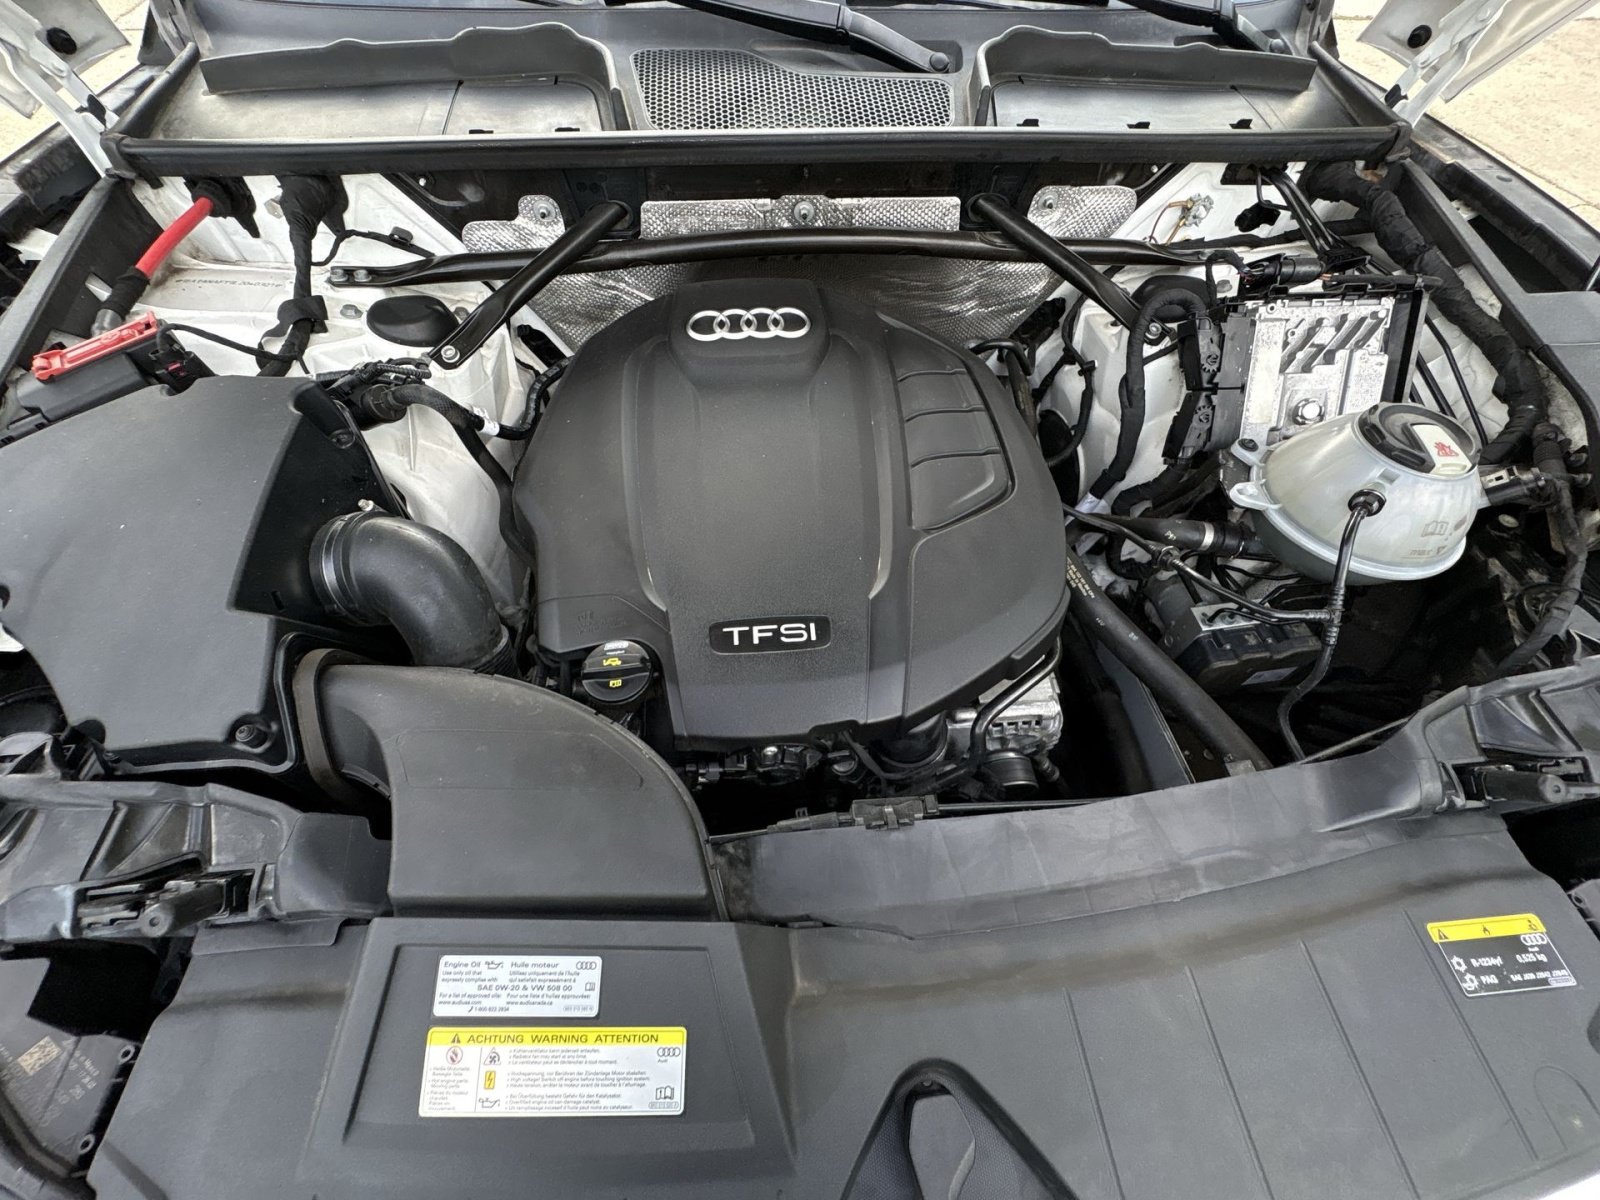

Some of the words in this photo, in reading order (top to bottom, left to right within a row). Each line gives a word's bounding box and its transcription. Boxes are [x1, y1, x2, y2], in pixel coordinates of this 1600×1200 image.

[722, 622, 817, 646] TFSI
[444, 961, 469, 969] Engine
[467, 1034, 524, 1044] ACHTUNG
[531, 1034, 588, 1043] WARNING
[594, 1033, 659, 1043] ATTENTION
